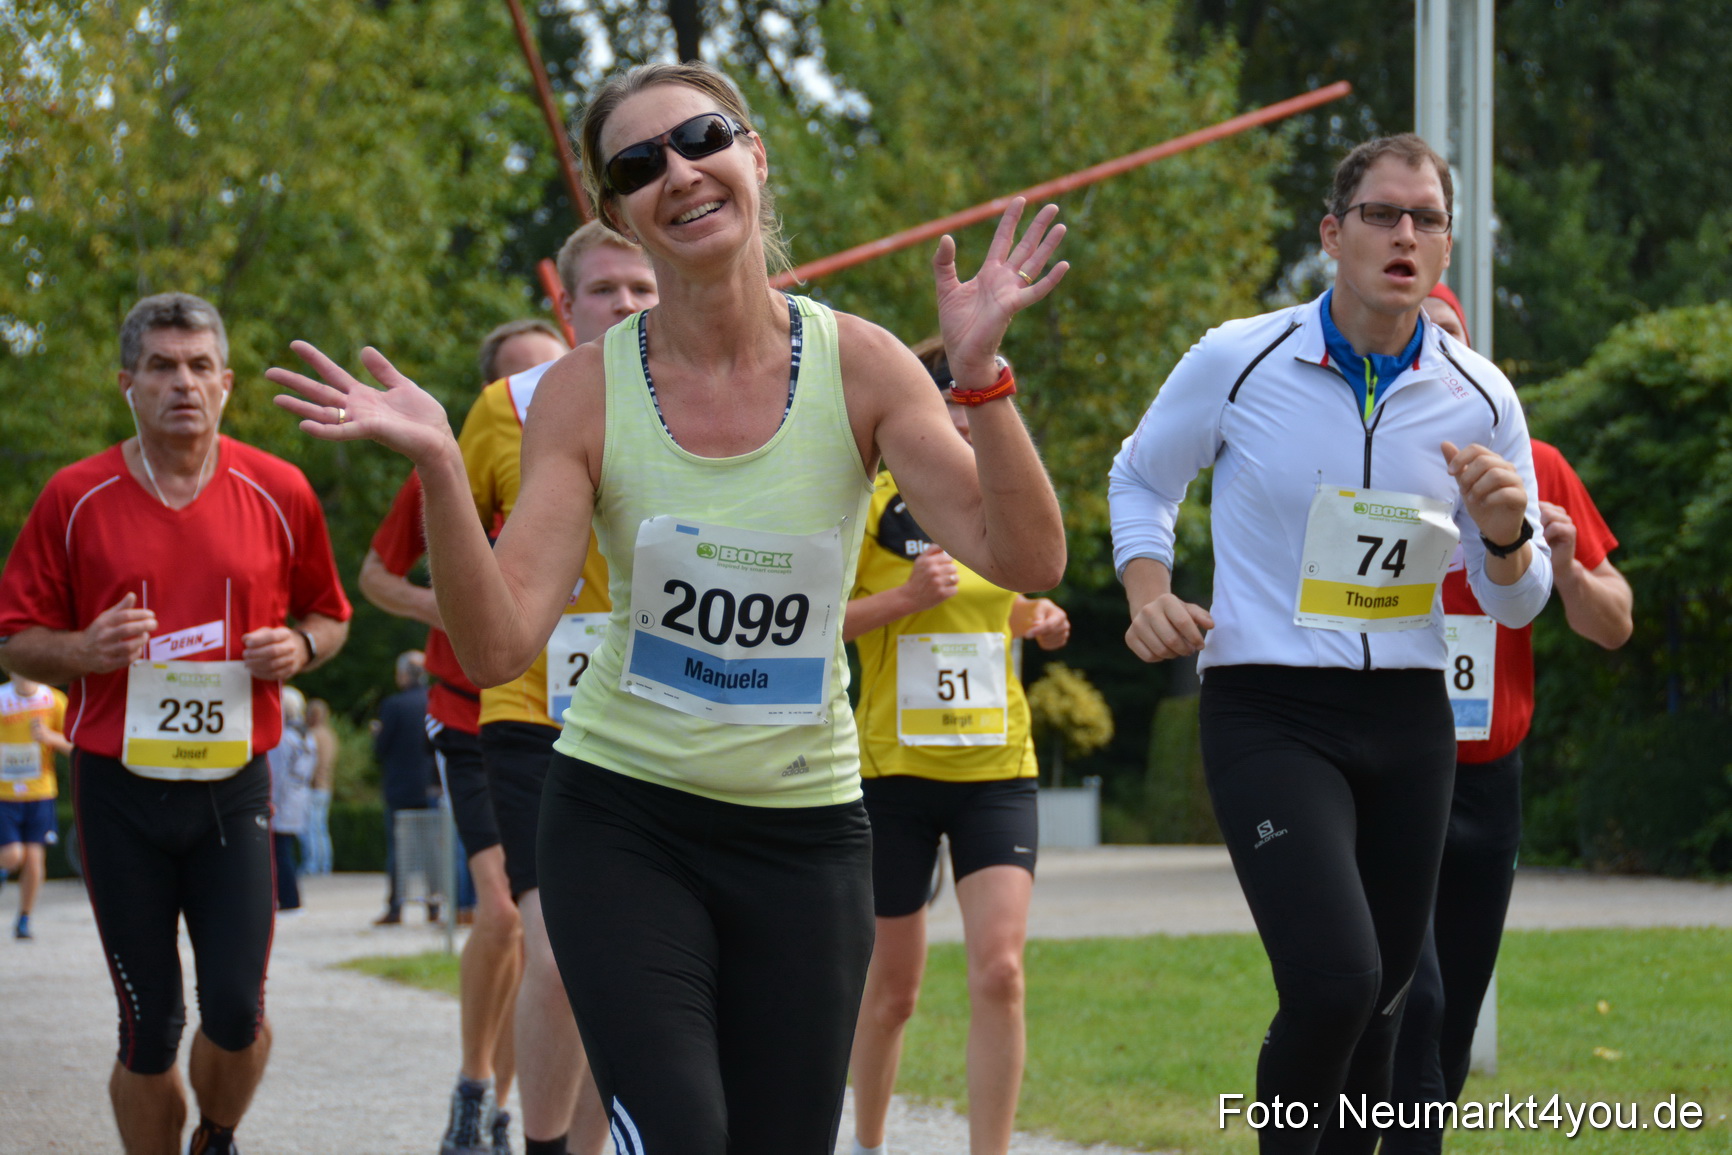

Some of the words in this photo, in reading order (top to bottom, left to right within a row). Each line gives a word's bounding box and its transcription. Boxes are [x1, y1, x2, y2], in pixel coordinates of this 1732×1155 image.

[1369, 504, 1421, 521] BOCK
[718, 545, 793, 568] BOCK
[905, 540, 930, 555] Bl
[1357, 535, 1408, 578] 74
[717, 562, 740, 570] inspired
[1346, 591, 1399, 608] Thomas
[641, 614, 649, 624] D
[661, 579, 809, 648] 2099
[170, 633, 204, 651] DEHN
[568, 653, 590, 687] 2
[684, 657, 768, 689] Manuela
[937, 668, 970, 701] 51
[158, 698, 224, 734] 235
[172, 746, 208, 759] Josef
[781, 767, 809, 777] adidas
[1254, 828, 1288, 849] salomon
